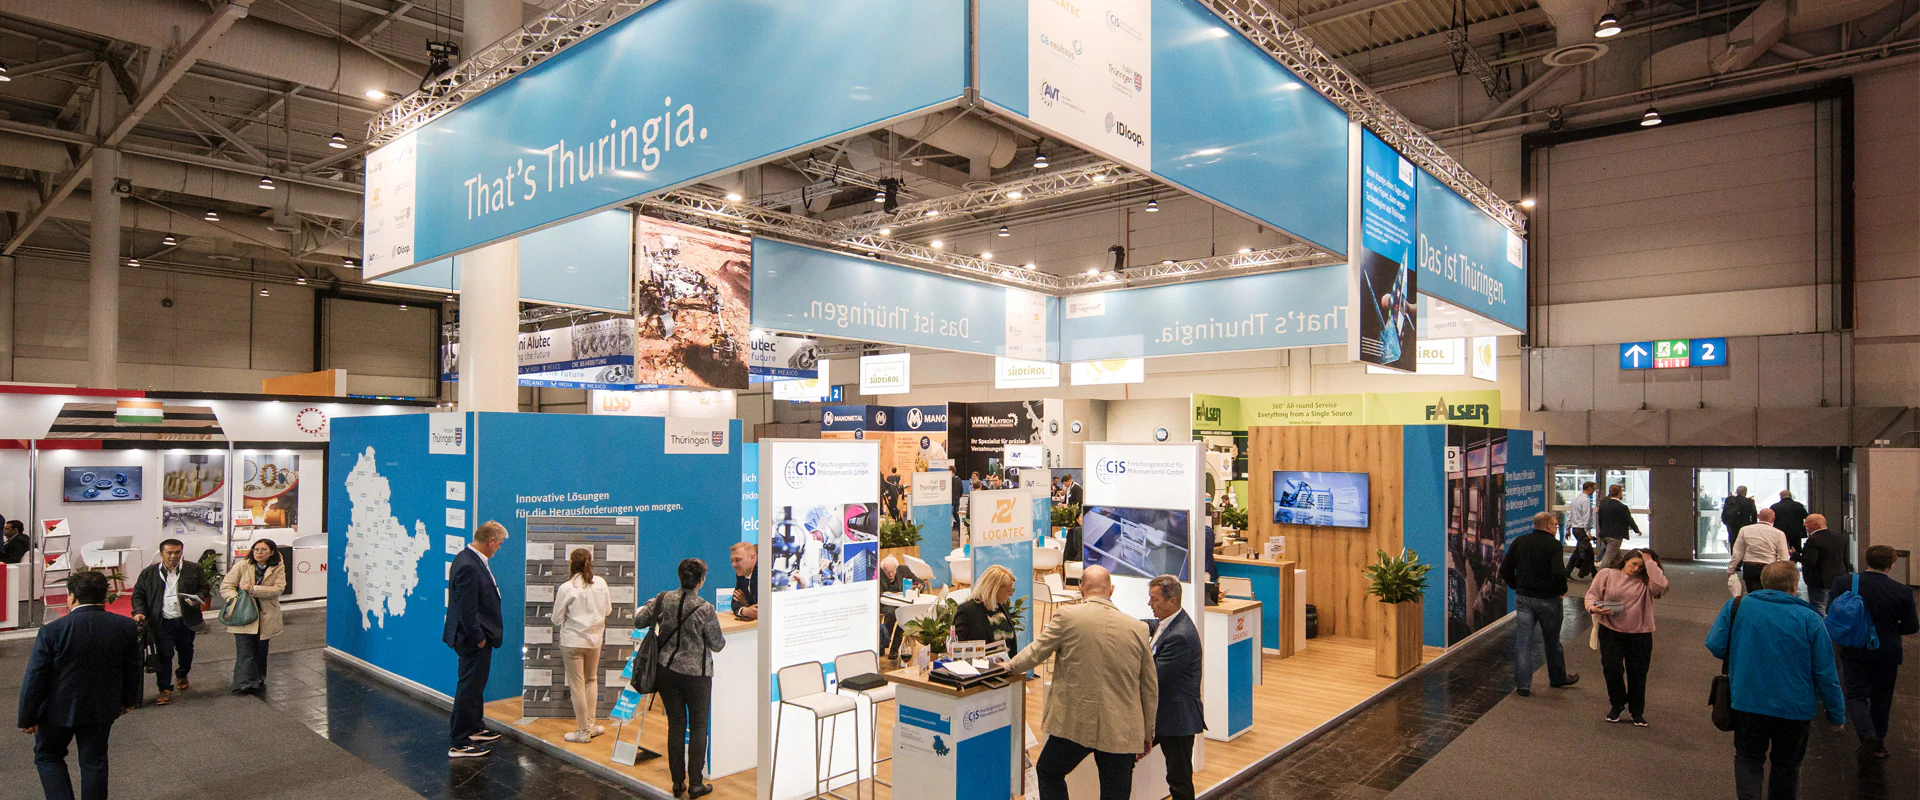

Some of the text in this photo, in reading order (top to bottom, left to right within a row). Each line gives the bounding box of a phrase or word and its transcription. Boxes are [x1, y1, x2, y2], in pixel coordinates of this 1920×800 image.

[1050, 39, 1075, 60] neuhaus
[1108, 63, 1133, 84] Thüringen
[1044, 84, 1060, 101] AVT
[464, 96, 708, 220] That's Thuringia.
[1420, 232, 1506, 305] Das ist Thüringen.
[527, 336, 551, 350] Alutec
[525, 352, 533, 360] the
[534, 351, 551, 359] future
[751, 353, 776, 362] future
[1701, 343, 1715, 360] 2
[521, 379, 544, 387] POLAND
[833, 389, 839, 399] 2
[1196, 399, 1222, 426] FALSER
[1258, 411, 1289, 419] Everything
[1311, 410, 1329, 418] Single
[1425, 396, 1489, 425] FALSER
[924, 414, 947, 423] MANO
[971, 416, 994, 424] WMH
[432, 433, 454, 446] Thüringen
[670, 434, 710, 447] Thüringen
[1447, 451, 1456, 459] D
[795, 461, 816, 476] CiS
[1106, 460, 1126, 474] CiS
[1127, 461, 1174, 469] Forschungsinstitut
[516, 492, 610, 503] Innovative Lösungen
[516, 508, 530, 518] für
[532, 507, 547, 517] die
[550, 505, 633, 517] Herausforderungen
[651, 502, 683, 513] morgen.
[983, 527, 1025, 541] LOGATEC
[1232, 631, 1248, 640] LOGATEC
[968, 710, 980, 721] CiS
